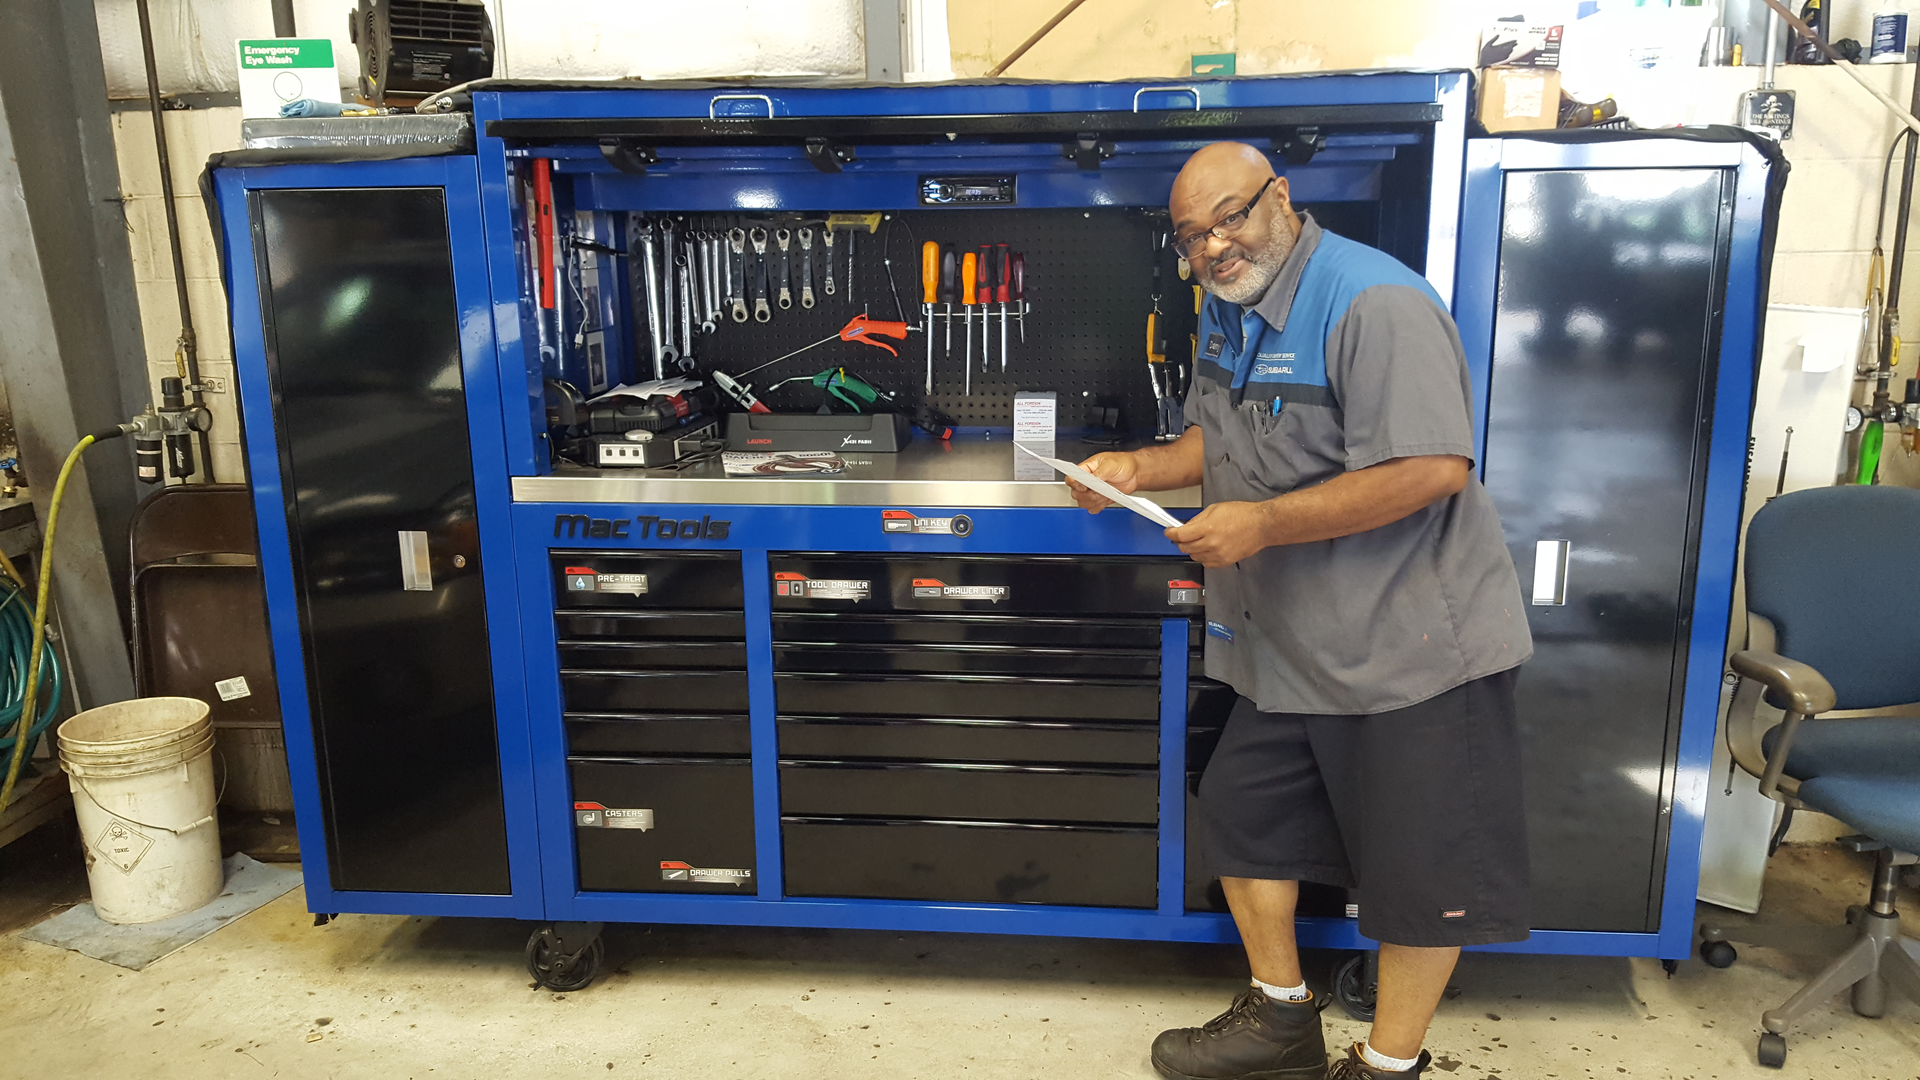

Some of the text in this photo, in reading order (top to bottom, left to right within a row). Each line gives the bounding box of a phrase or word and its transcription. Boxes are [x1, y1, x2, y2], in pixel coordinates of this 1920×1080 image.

[244, 46, 300, 55] Emergency
[245, 55, 293, 65] Eye Wash
[553, 514, 732, 540] Mac Tools
[914, 519, 948, 527] UNI KEY
[597, 575, 645, 583] PRE-TREAT
[806, 580, 868, 589] TOOL DRAWER
[943, 587, 979, 595] DRAWER
[690, 869, 723, 877] DRAWER
